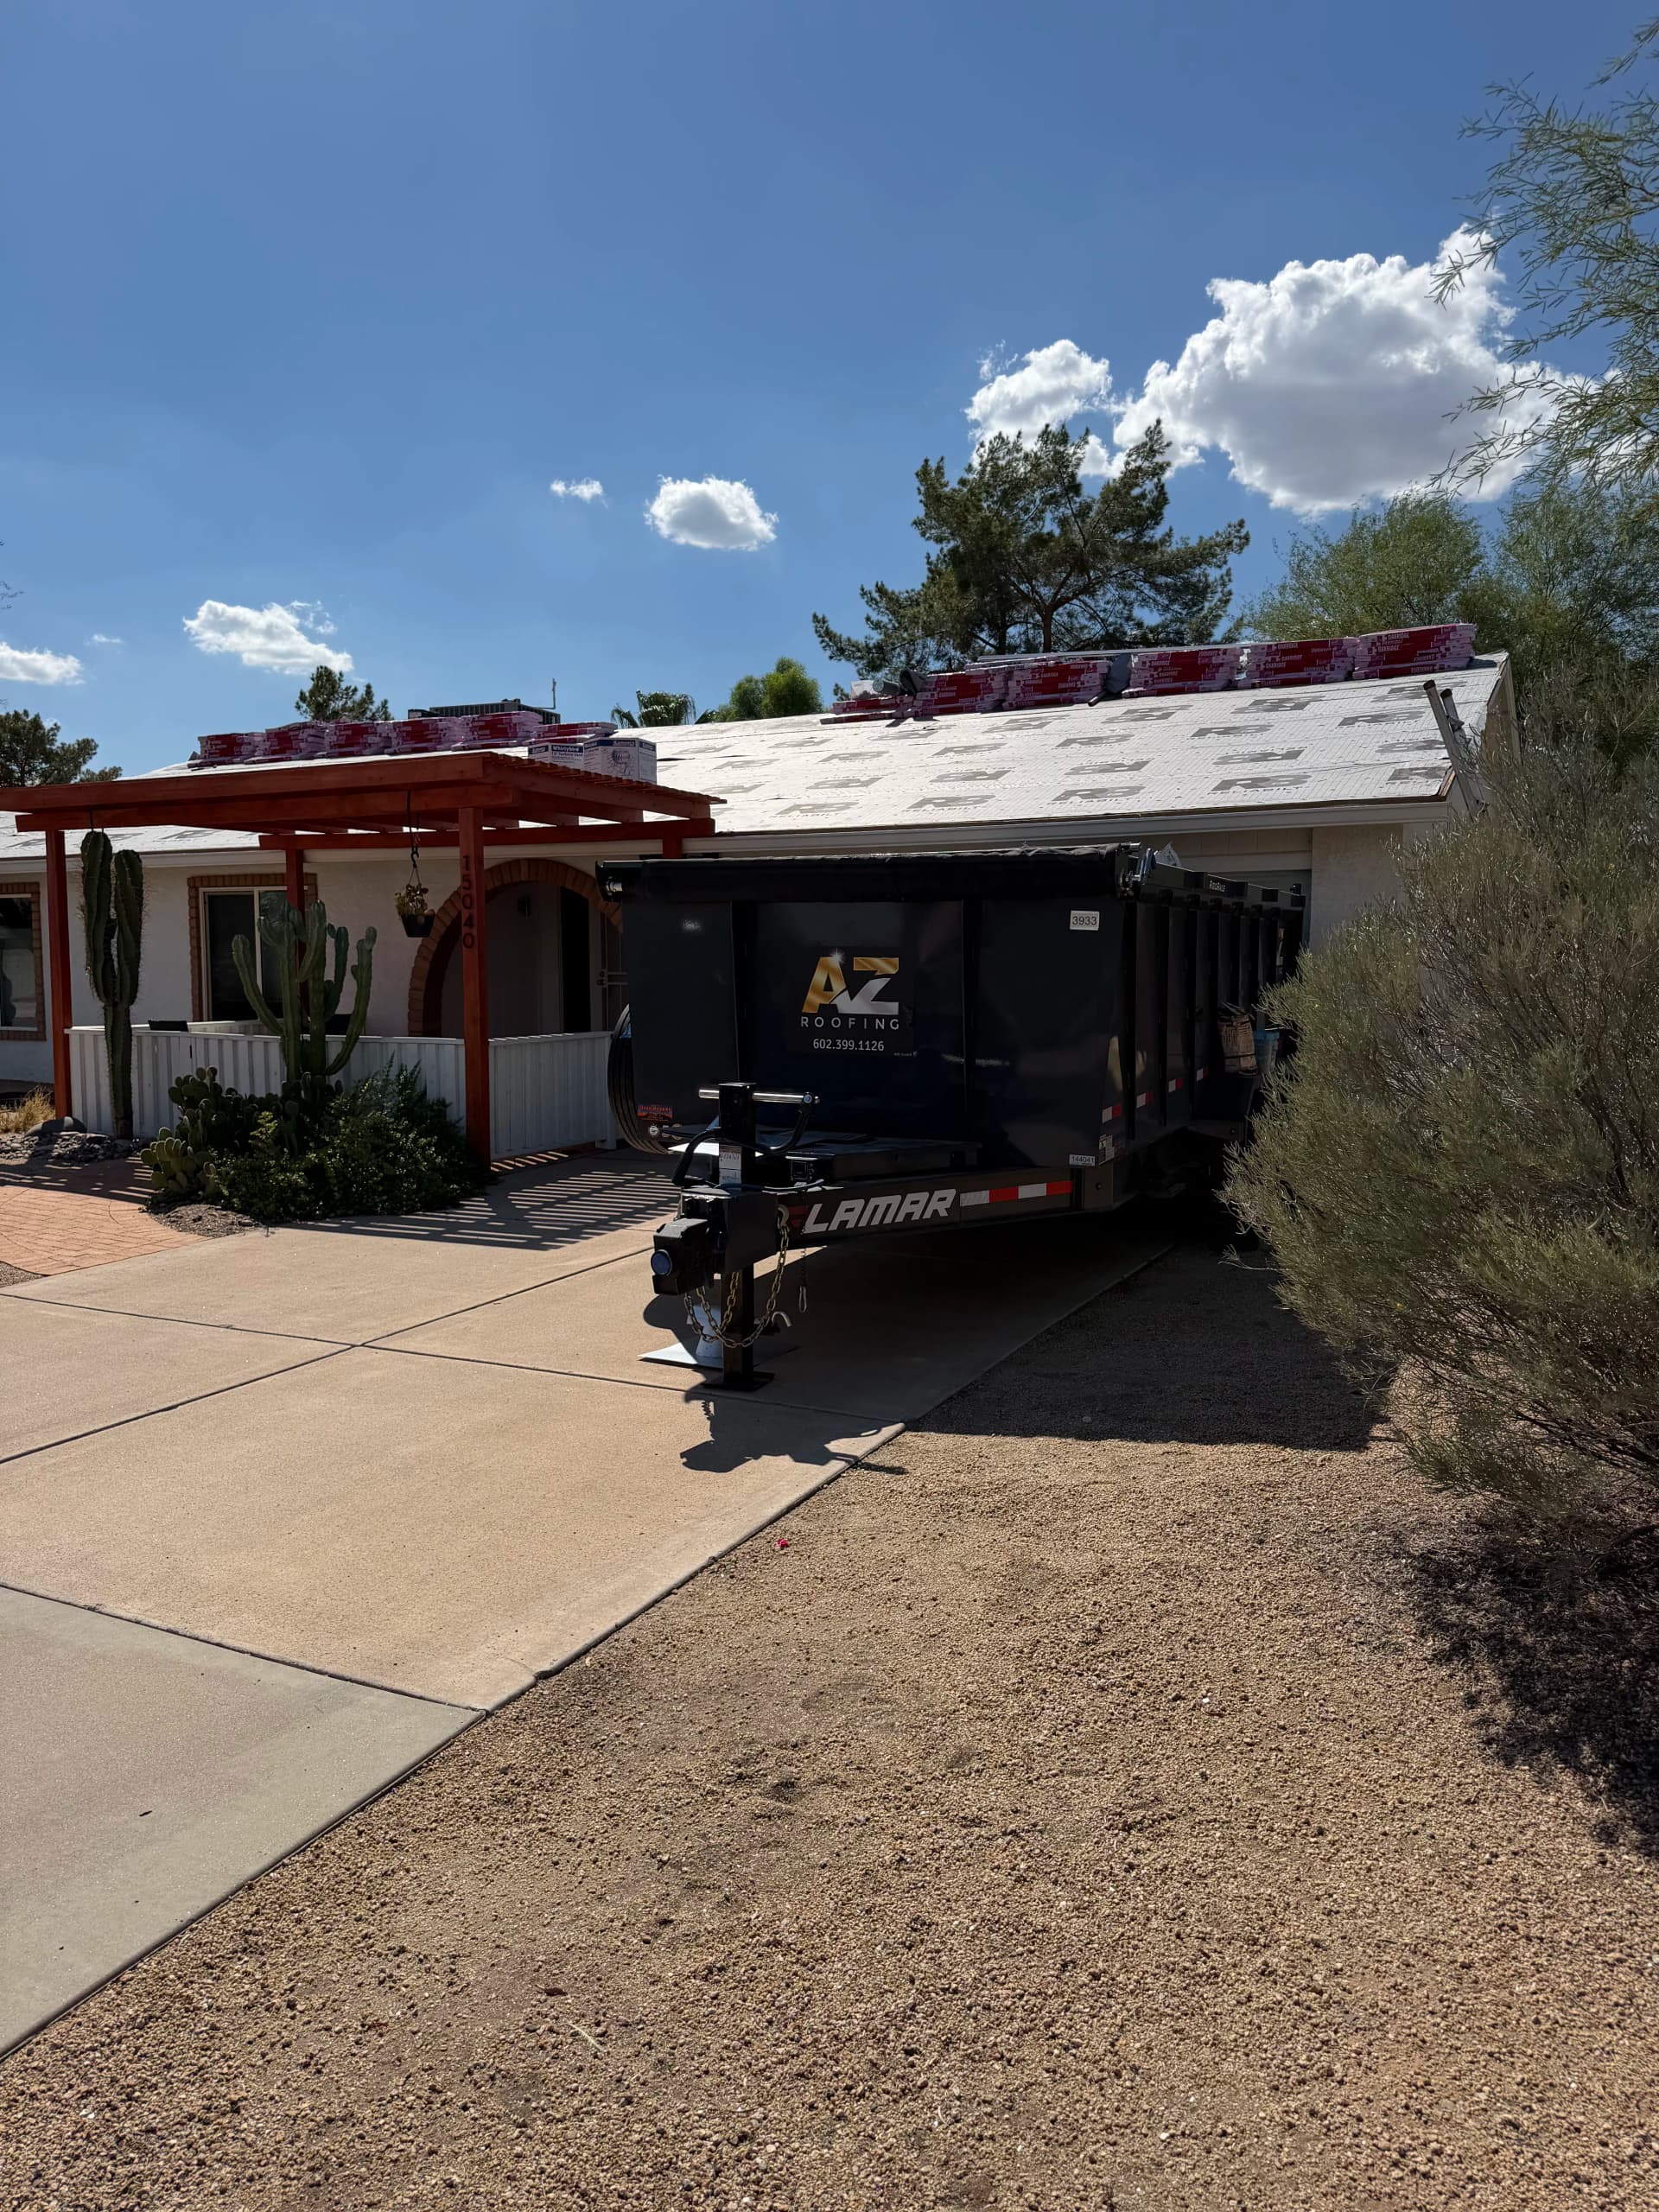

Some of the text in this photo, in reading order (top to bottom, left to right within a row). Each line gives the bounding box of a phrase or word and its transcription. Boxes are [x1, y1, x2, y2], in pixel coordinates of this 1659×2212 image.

[462, 855, 474, 949] 15040
[1072, 916, 1097, 925] 3933
[801, 956, 899, 1015] AZ
[800, 1016, 899, 1030] ROOFING
[813, 1039, 885, 1052] 602.399.1126
[802, 1188, 957, 1235] LAMAR
